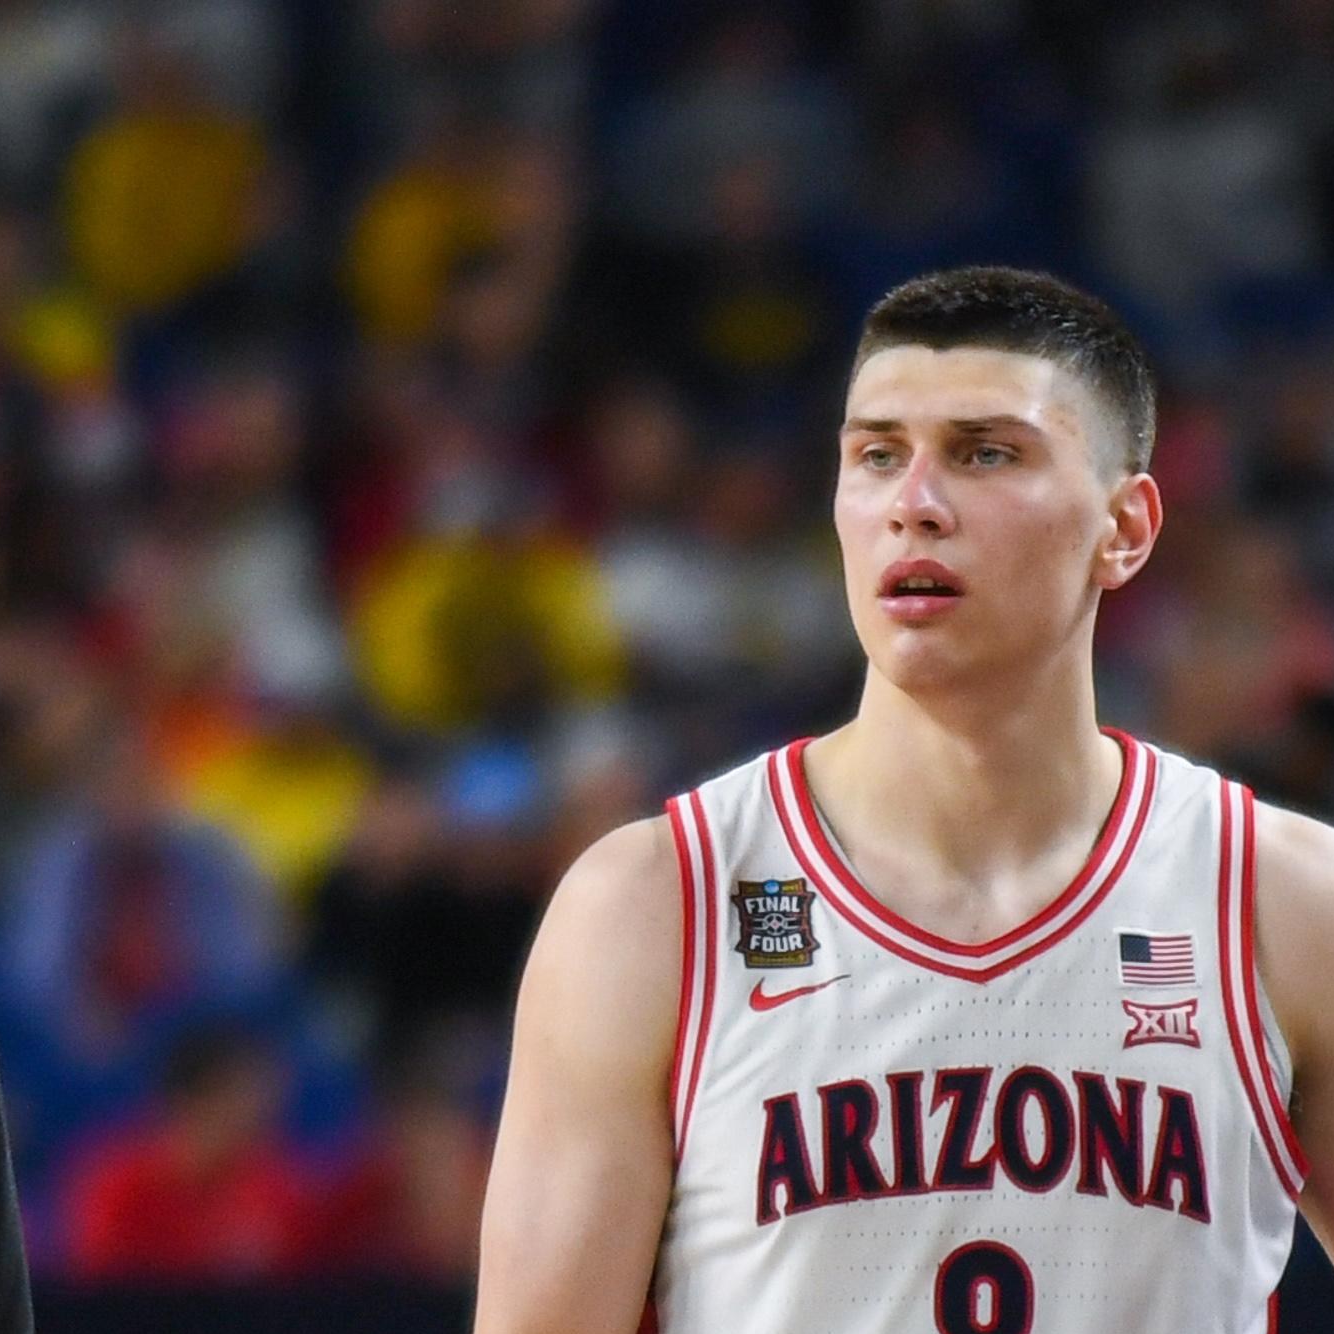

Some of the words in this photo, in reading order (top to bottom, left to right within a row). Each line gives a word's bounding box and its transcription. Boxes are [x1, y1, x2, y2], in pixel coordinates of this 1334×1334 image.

[744, 896, 801, 914] FINAL
[749, 933, 804, 953] FOUR
[757, 1065, 1211, 1227] ARIZONA
